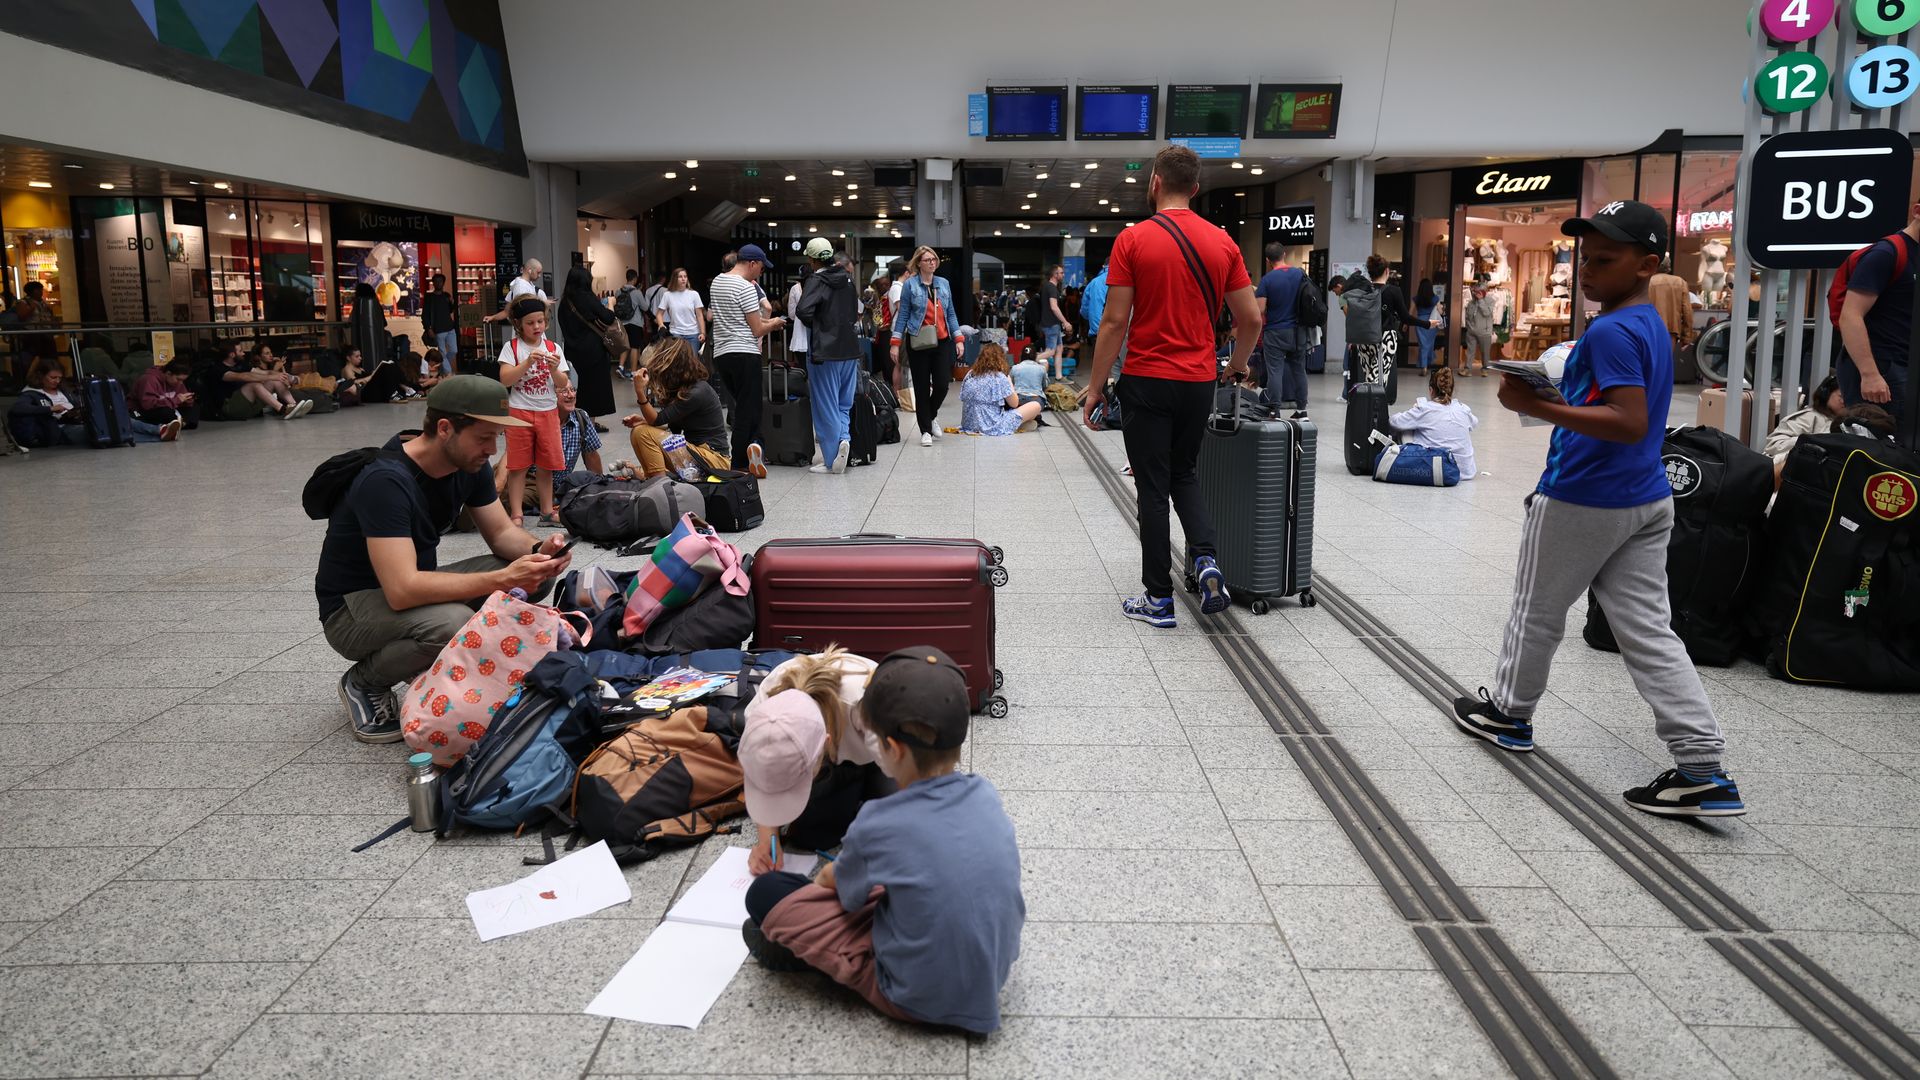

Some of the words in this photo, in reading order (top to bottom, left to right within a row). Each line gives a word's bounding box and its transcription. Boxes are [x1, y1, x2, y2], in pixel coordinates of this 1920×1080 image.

[1780, 0, 1810, 28] 4
[1876, 0, 1906, 22] 6
[1768, 63, 1817, 100] 12
[1859, 58, 1910, 94] 13
[1049, 99, 1058, 134] départs
[1138, 95, 1148, 129] départs
[1475, 170, 1552, 195] Etam
[1782, 178, 1876, 221] BUS
[359, 210, 403, 231] KUSMI
[405, 215, 432, 233] TEA
[127, 237, 154, 251] BO
[1871, 490, 1907, 506] OMS
[1859, 566, 1873, 591] OMS
